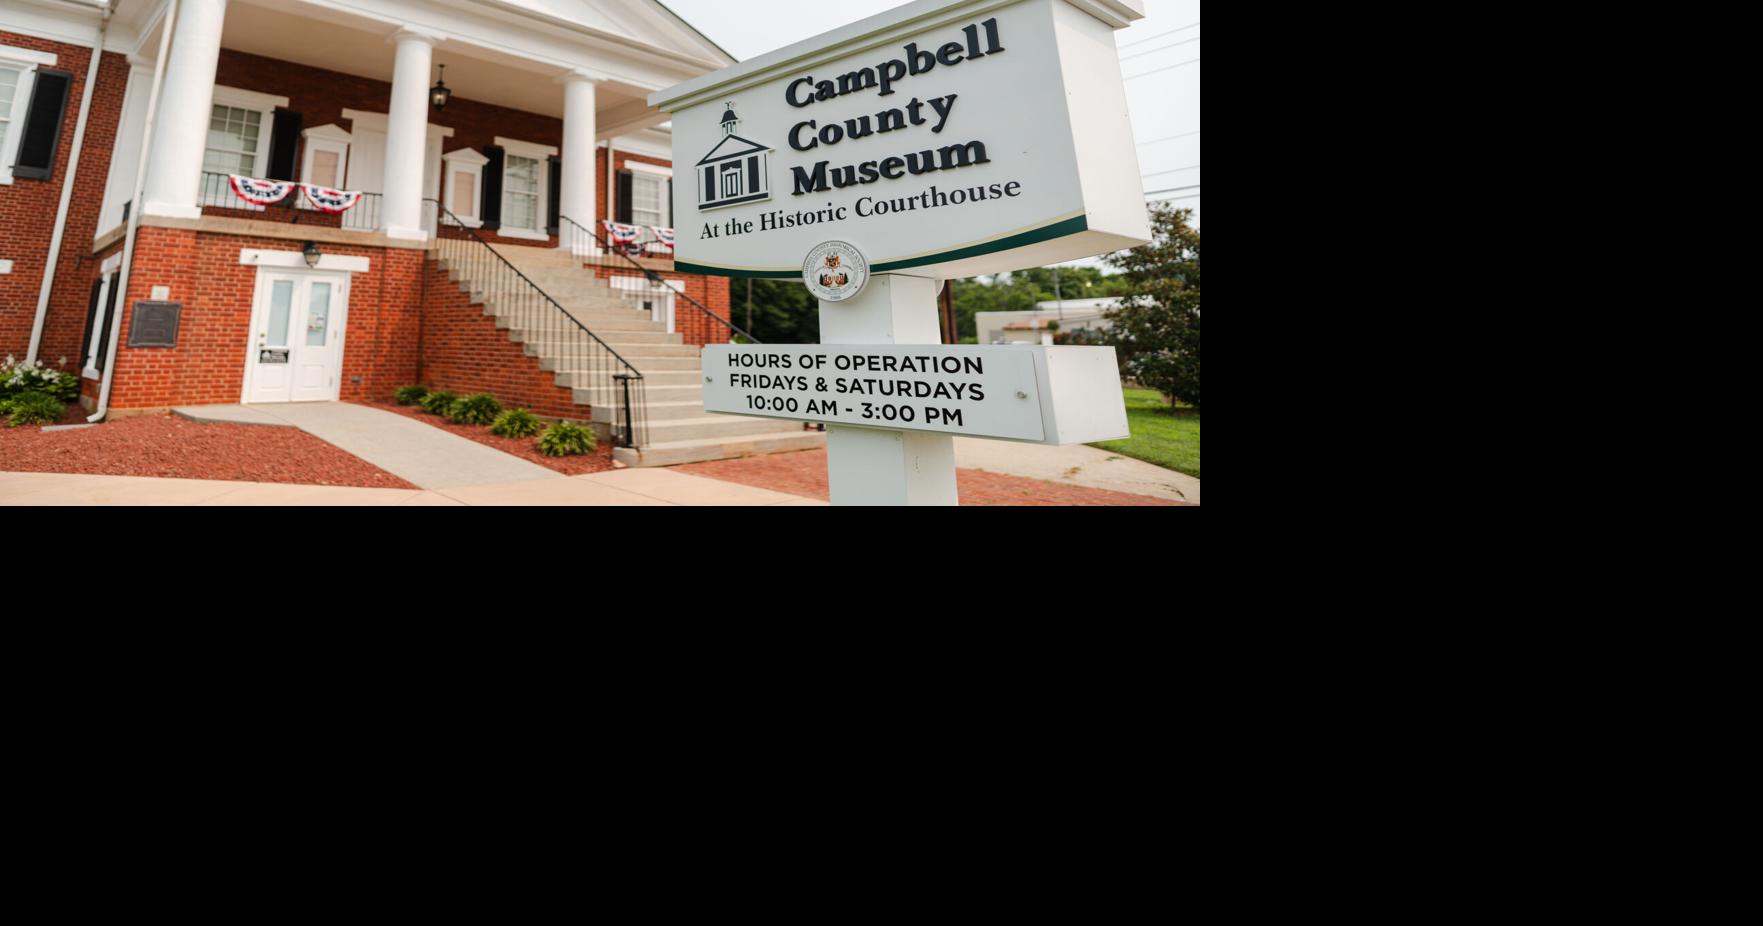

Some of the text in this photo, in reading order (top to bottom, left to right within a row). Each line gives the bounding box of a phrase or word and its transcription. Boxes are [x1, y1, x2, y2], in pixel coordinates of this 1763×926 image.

[785, 17, 1005, 108] Campbell
[787, 93, 958, 152] County
[789, 140, 991, 196] Museum
[701, 181, 1021, 239] At the Historic Courthouse
[728, 353, 984, 375] HOURS OF OPERATION
[729, 373, 985, 402] FRIDAYS & SATURDAYS
[746, 394, 799, 413] 10:00
[805, 398, 838, 416] AM
[860, 402, 916, 423] 3:00
[924, 406, 964, 427] PM
